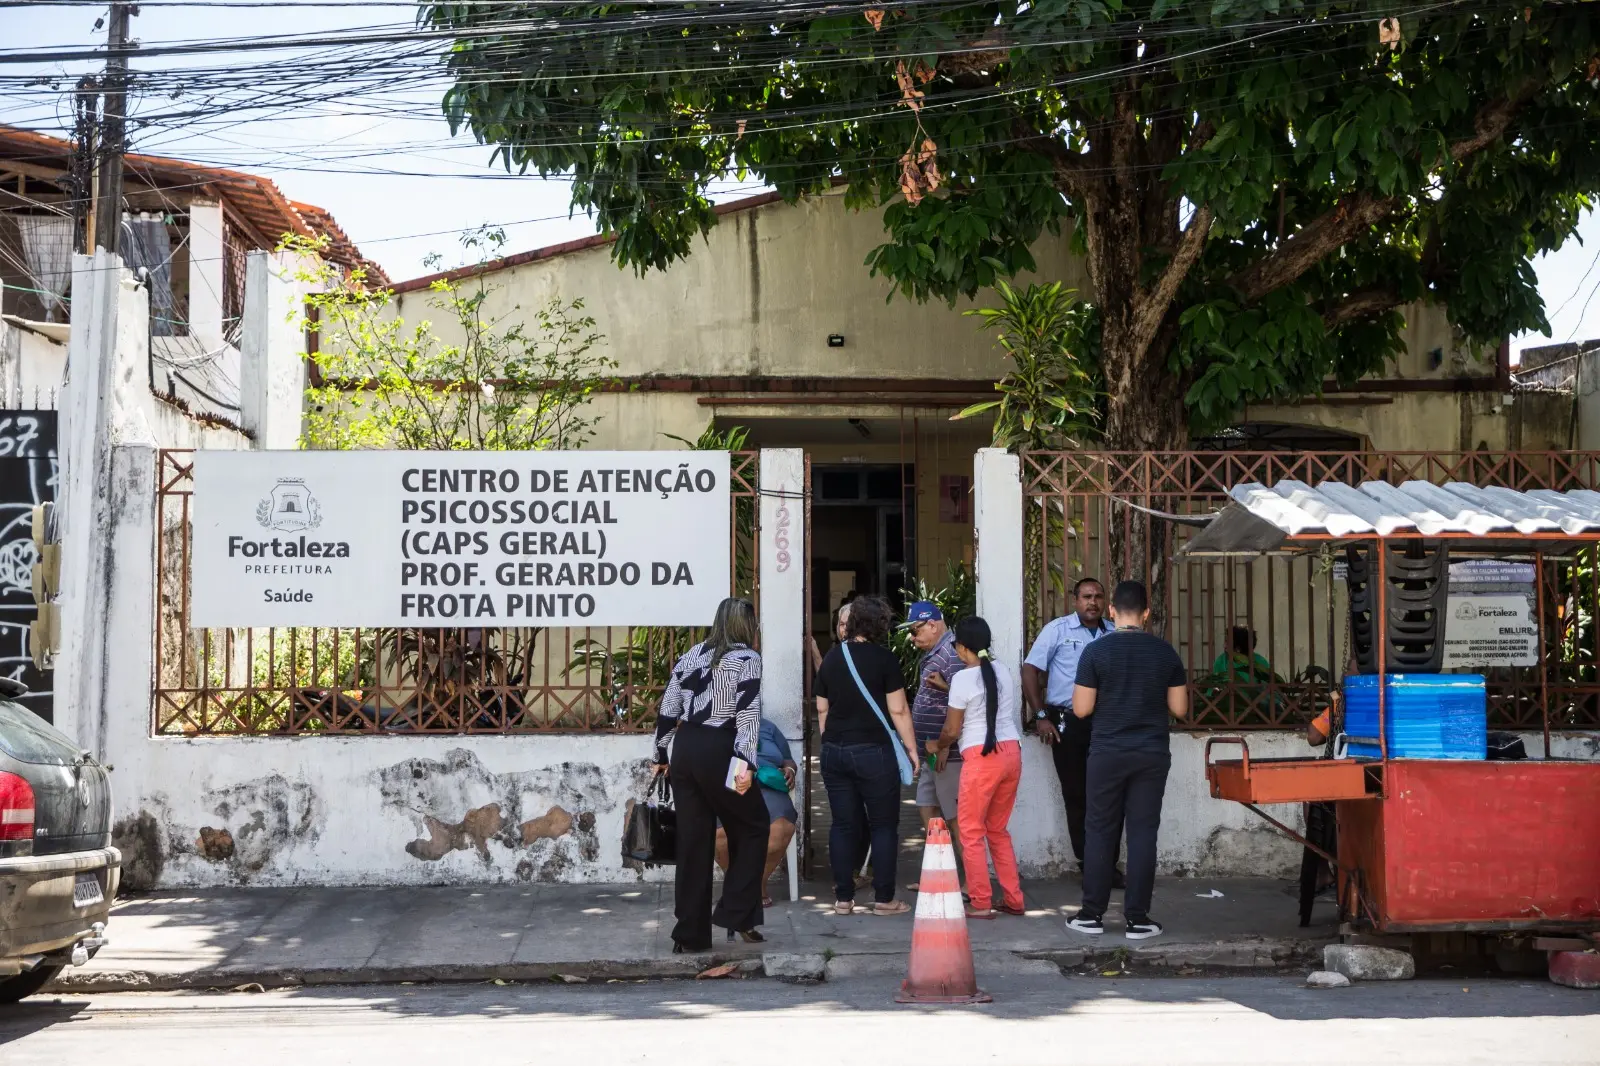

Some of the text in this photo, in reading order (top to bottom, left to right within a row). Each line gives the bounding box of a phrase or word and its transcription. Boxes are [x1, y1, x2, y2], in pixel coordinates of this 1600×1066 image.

[401, 463, 716, 500] CENTRO DE ATENÇÃO
[401, 500, 618, 524] PSICOSSOCIAL
[228, 535, 350, 558] Fortaleza
[400, 529, 607, 559] (CAPS GERAL)
[244, 564, 333, 574] PREFEITURA
[401, 562, 694, 587] PROF. GERARDO DA
[263, 587, 314, 603] Saúde
[400, 593, 596, 618] FROTA PINTO
[1478, 609, 1518, 617] Fortaleza
